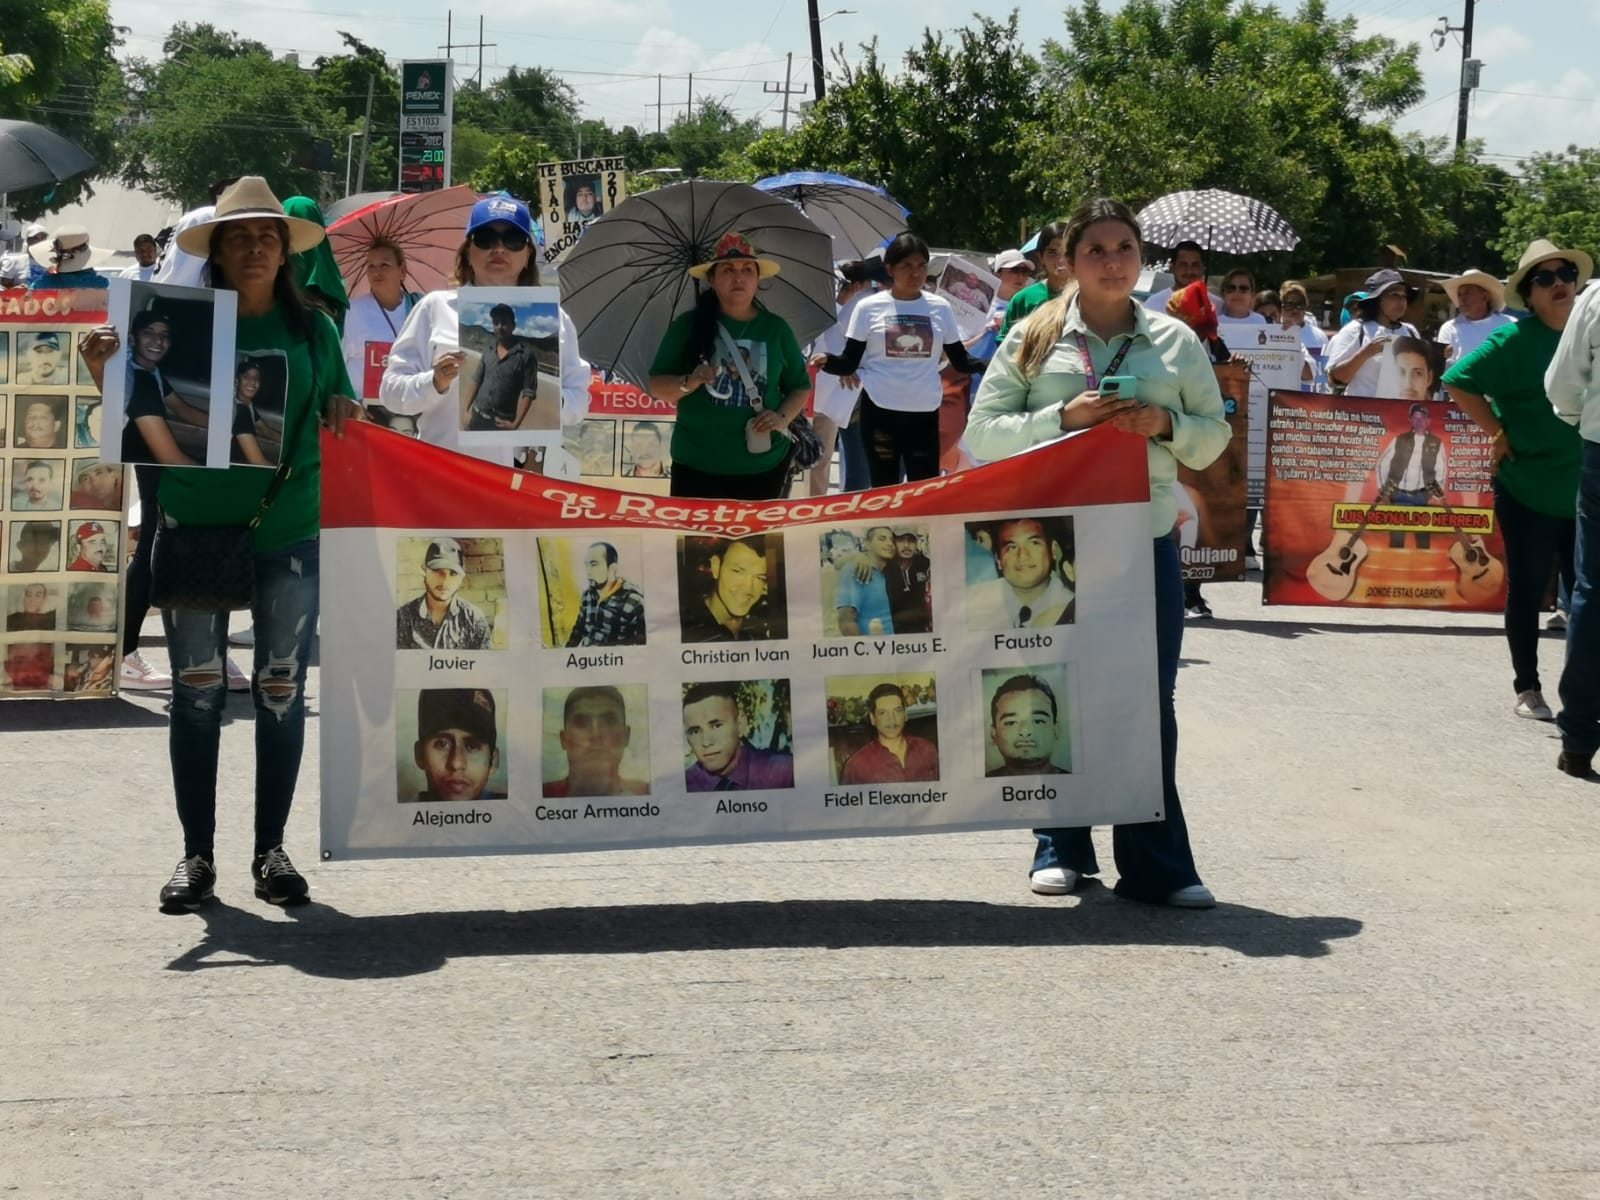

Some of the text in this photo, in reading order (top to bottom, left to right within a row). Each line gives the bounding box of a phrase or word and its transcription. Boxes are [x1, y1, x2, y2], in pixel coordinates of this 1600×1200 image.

[405, 91, 440, 100] PEMEX
[538, 157, 625, 178] TE BUSCARE
[1272, 433, 1285, 442] que
[1285, 432, 1311, 443] muchos
[1358, 424, 1386, 436] guitarra
[1271, 445, 1294, 454] cuando
[1336, 508, 1491, 529] LUIS REYNALDO HERRERA
[1181, 546, 1238, 566] Quijano
[1189, 567, 1215, 579] 2017
[812, 638, 947, 659] Juan C. Y Jesus E.
[994, 633, 1053, 651] Fausto
[429, 655, 476, 671] Javier
[681, 647, 790, 665] Christian Ivan
[824, 788, 949, 808] Fidel Elexander
[1001, 784, 1057, 803] Bardo
[535, 802, 660, 822] Cesar Armando
[715, 799, 768, 815] Alonso
[412, 808, 492, 828] Alejandro
